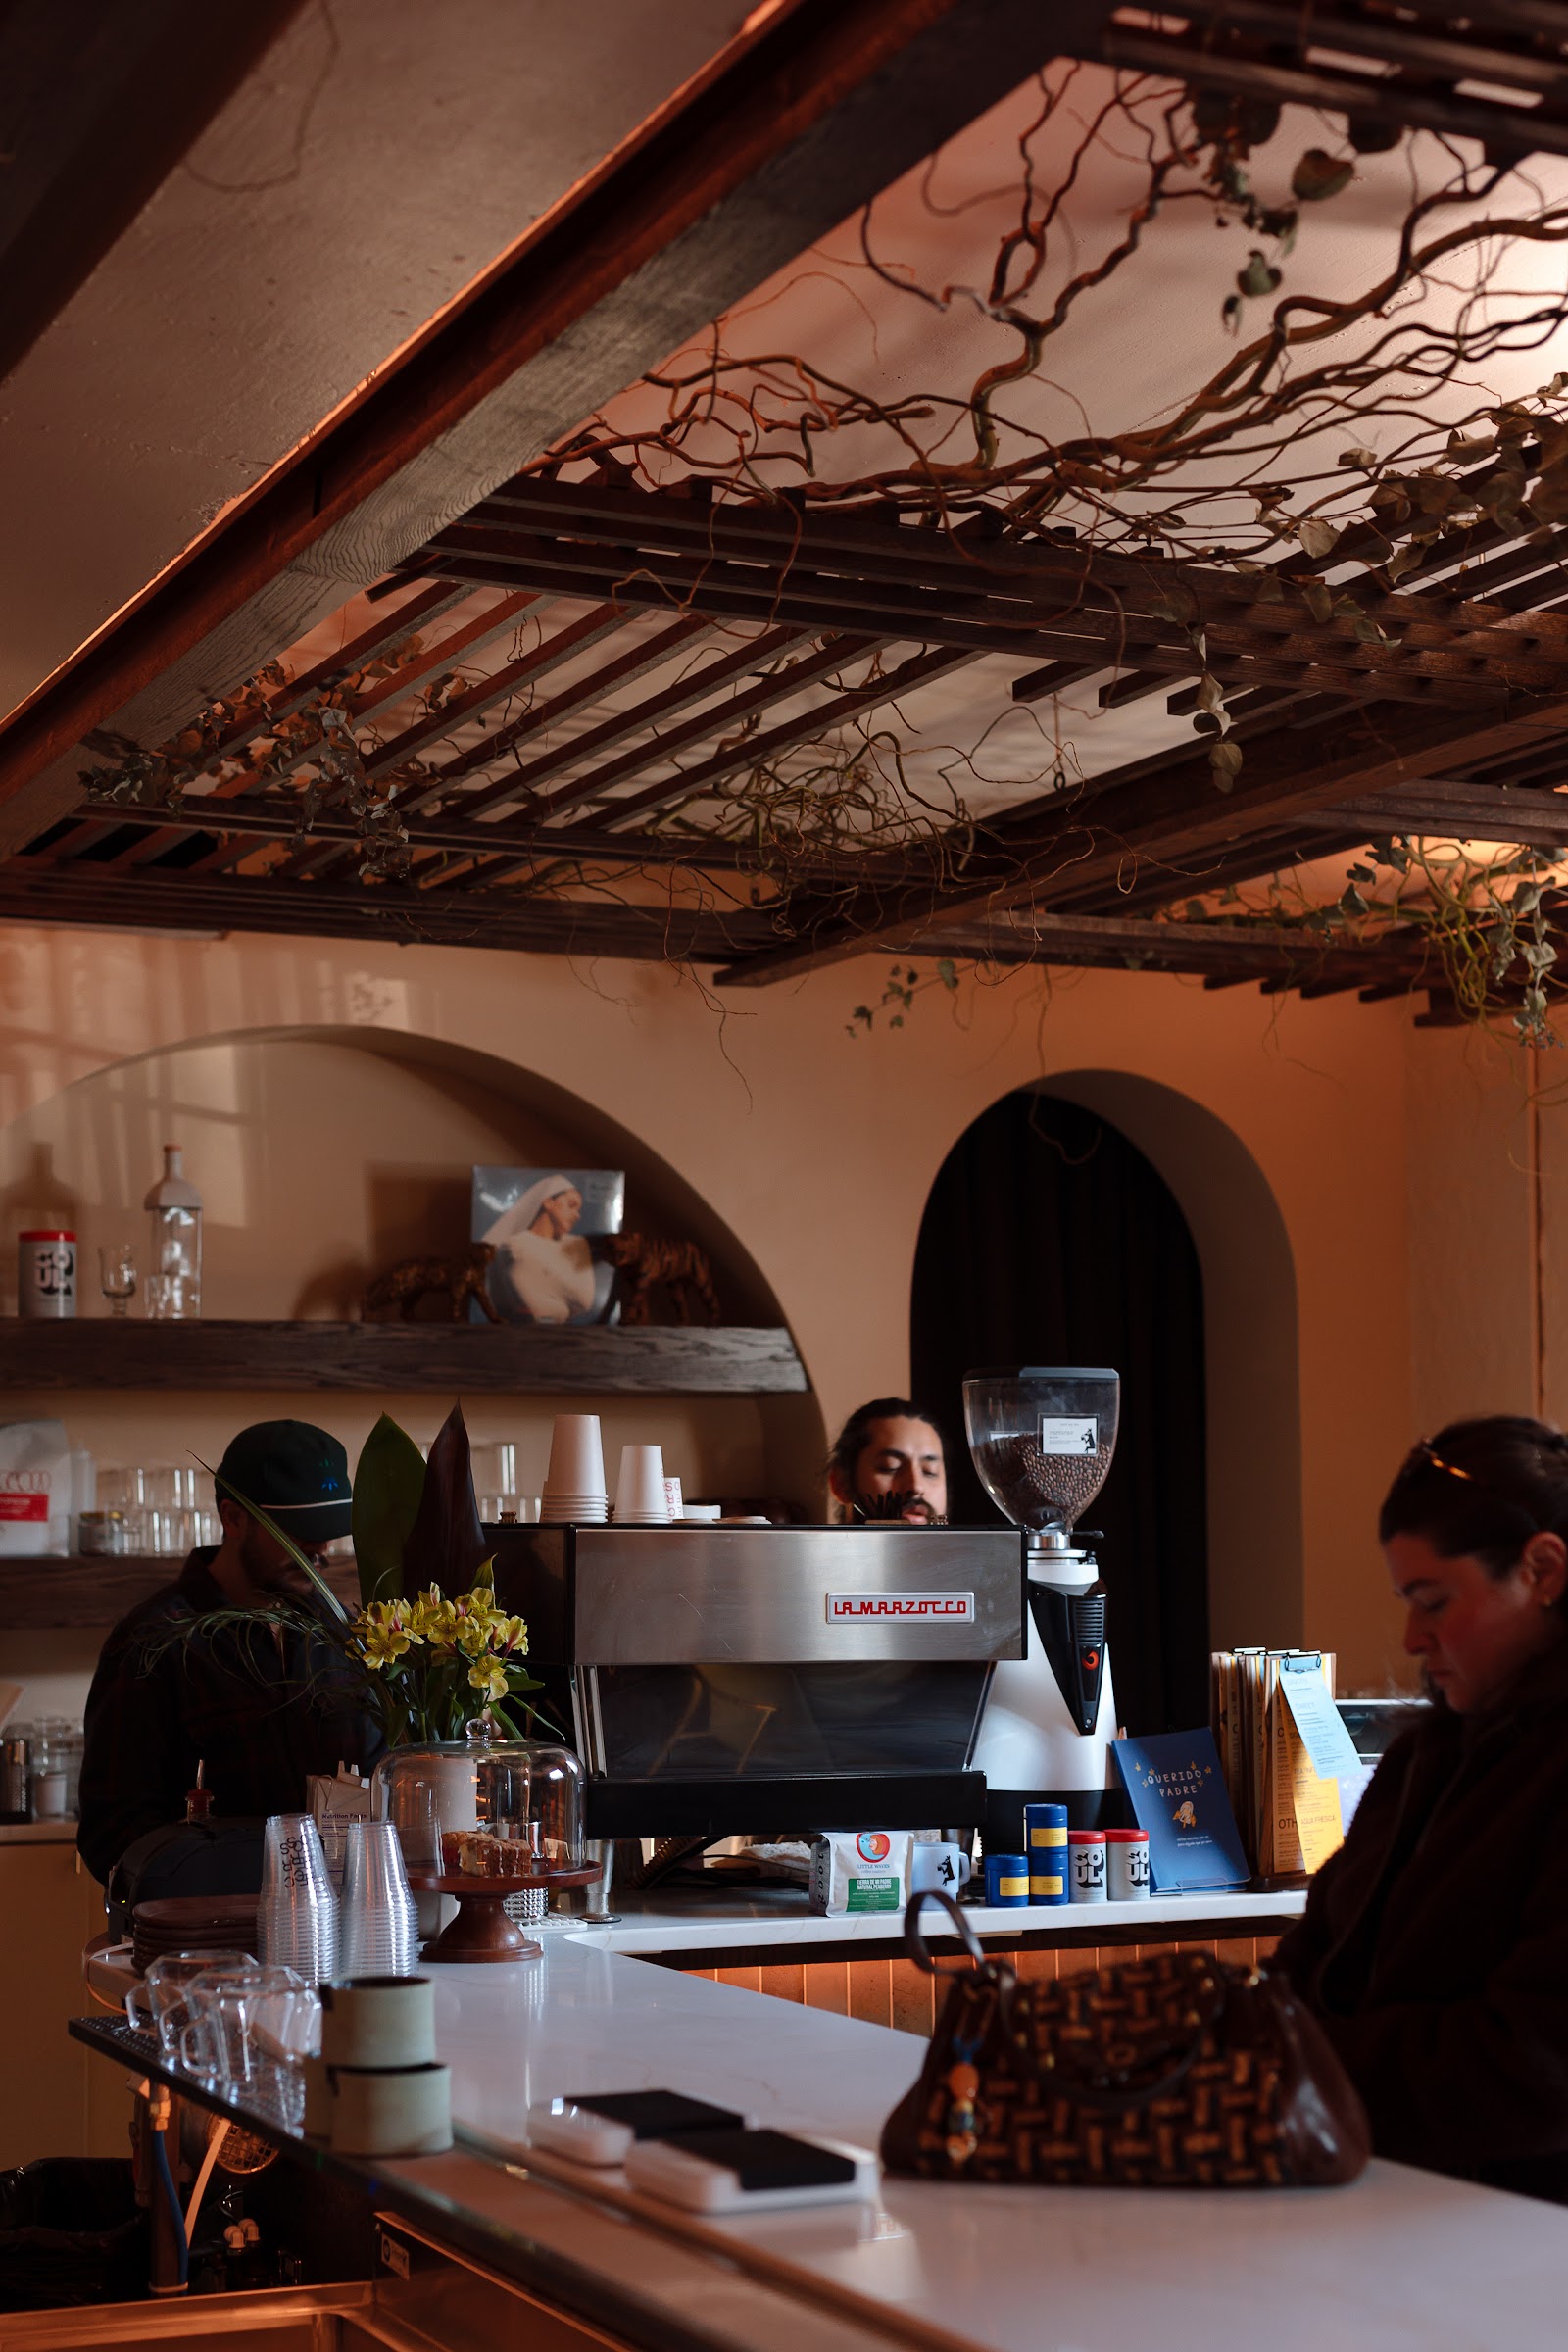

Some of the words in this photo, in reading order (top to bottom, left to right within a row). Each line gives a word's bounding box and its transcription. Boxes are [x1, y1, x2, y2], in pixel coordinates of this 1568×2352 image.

[834, 1601, 852, 1615] LA
[860, 1600, 967, 1615] MARZOCCO
[1147, 1770, 1202, 1785] QUERIDO
[1158, 1785, 1198, 1798] PADRE
